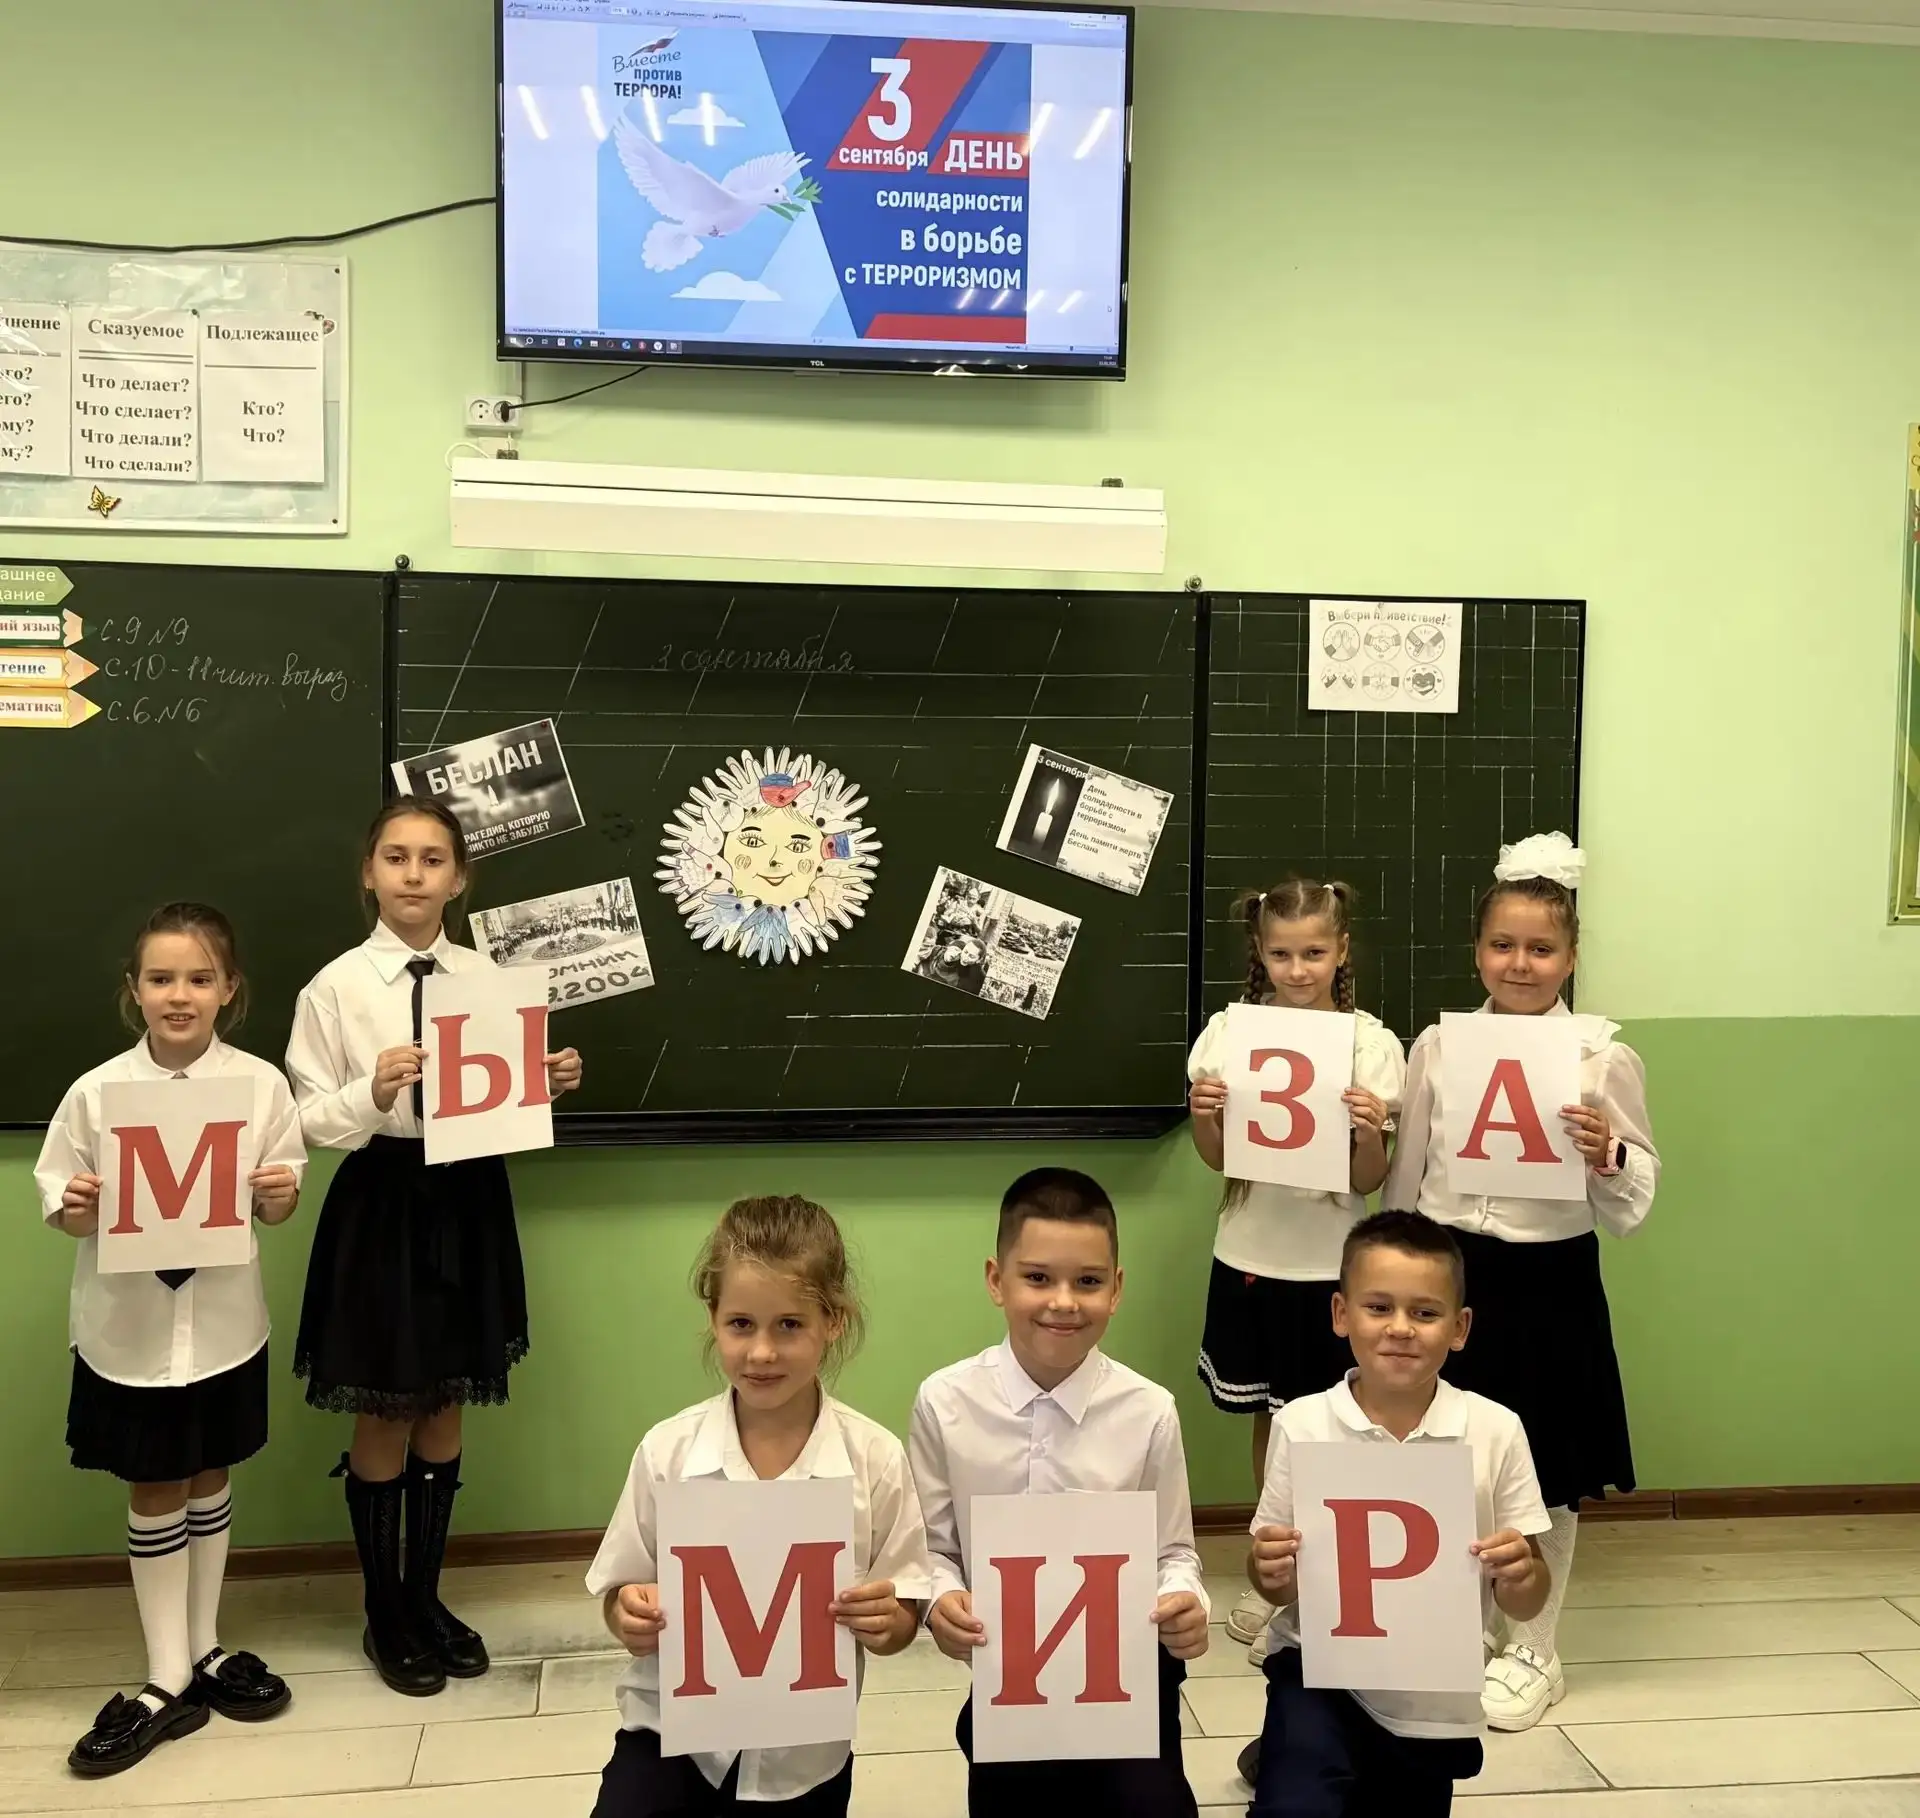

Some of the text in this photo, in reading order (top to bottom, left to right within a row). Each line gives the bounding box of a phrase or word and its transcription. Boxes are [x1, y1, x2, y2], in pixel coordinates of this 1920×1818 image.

[612, 51, 681, 73] Вместе
[634, 68, 682, 82] против
[614, 82, 682, 99] ТЕРРОРА!
[867, 57, 912, 141] 3
[838, 145, 928, 170] сентября
[944, 139, 1023, 172] ДЕНЬ
[876, 190, 1023, 214] солидарности
[900, 222, 1022, 259] в борьбе
[844, 263, 1021, 289] с ТЕРРОРИЗМОМ
[88, 318, 185, 340] Сказуемое
[206, 324, 319, 343] Подлежащее
[82, 373, 190, 394] Что делает?
[75, 401, 192, 422] Что сделает?
[242, 400, 285, 417] Кто?
[0, 419, 34, 436] му?
[80, 428, 192, 448] Что делали?
[243, 428, 285, 444] Что?
[84, 455, 193, 474] Что сделали?
[22, 622, 60, 633] язык
[426, 740, 542, 795] БЕСЛАН
[1037, 755, 1091, 779] 3 сентября
[1087, 784, 1107, 797] День
[1079, 802, 1107, 817] борьбе
[1083, 793, 1136, 816] солидарности
[508, 811, 550, 830] КОТОРУЮ
[1077, 812, 1127, 834] терроризмом
[496, 833, 510, 845] НЕ
[510, 821, 551, 841] ЗАБУДЕТ
[1067, 837, 1099, 854] Беслана
[1069, 829, 1142, 859] День памяти жертв
